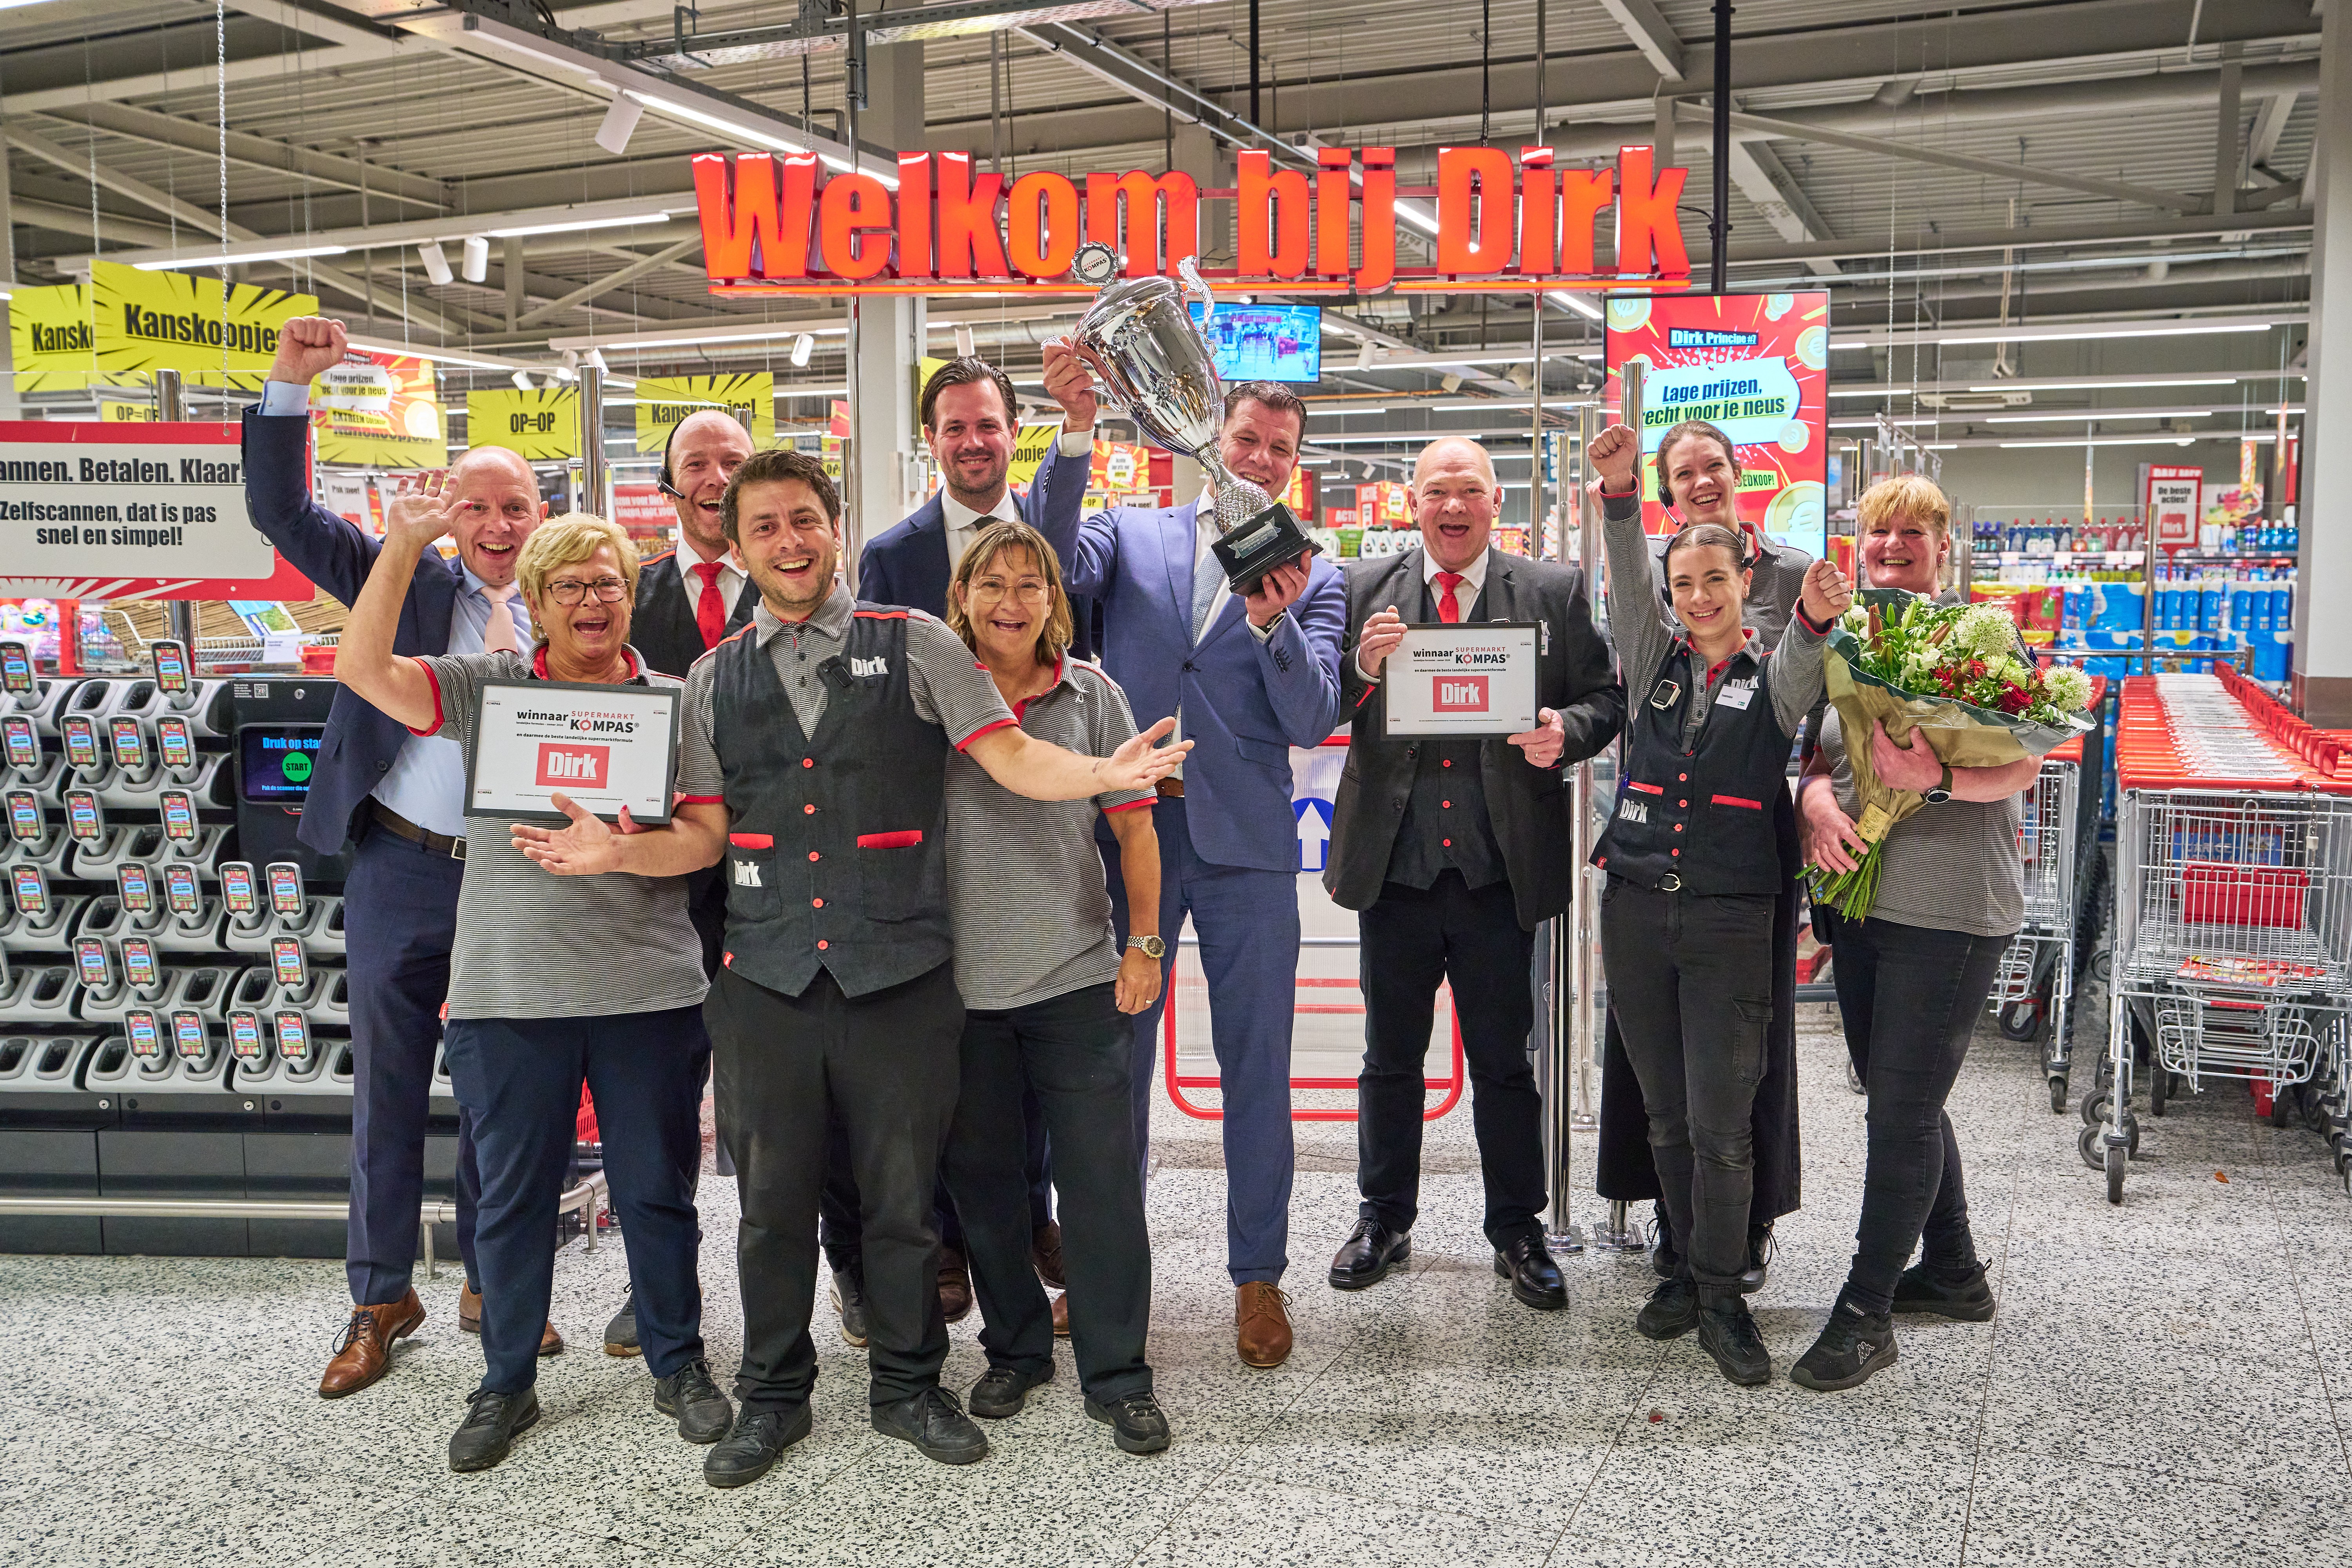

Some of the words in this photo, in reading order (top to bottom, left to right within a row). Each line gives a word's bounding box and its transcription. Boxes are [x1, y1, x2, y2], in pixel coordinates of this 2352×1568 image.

[690, 150, 1199, 281] Welkom
[1237, 145, 1397, 292] bij
[1436, 145, 1692, 284] Dirk
[1082, 255, 1104, 268] SUPERMARKT
[124, 303, 280, 353] Kanskoopje
[1671, 330, 1704, 345] Dirk
[1706, 332, 1746, 345] Principe
[368, 387, 387, 395] neus
[1662, 385, 1699, 403] Lage
[1702, 379, 1762, 400] prijzen,
[1684, 404, 1720, 421] voor
[1723, 400, 1739, 419] je
[1744, 397, 1785, 416] neus
[510, 412, 555, 433] OP=OP
[79, 457, 174, 483] Betalen.
[2170, 486, 2192, 495] beste
[0, 501, 122, 523] Zelfscannen,
[126, 503, 157, 523] dat
[161, 503, 178, 522] is
[183, 505, 216, 524] pas
[36, 525, 78, 544] snel
[83, 528, 107, 545] en
[111, 526, 183, 548] simpel!
[1413, 648, 1454, 657] winnaar
[851, 656, 889, 677] Dirk
[1441, 683, 1481, 705] Dirk
[517, 709, 568, 721] winnaar
[571, 710, 635, 720] SUPERMARKT
[263, 737, 287, 749] Druk
[288, 739, 302, 750] op
[285, 763, 308, 771] START
[547, 751, 597, 779] Dirk
[1619, 798, 1648, 824] Dirk
[734, 860, 762, 887] Dirk
